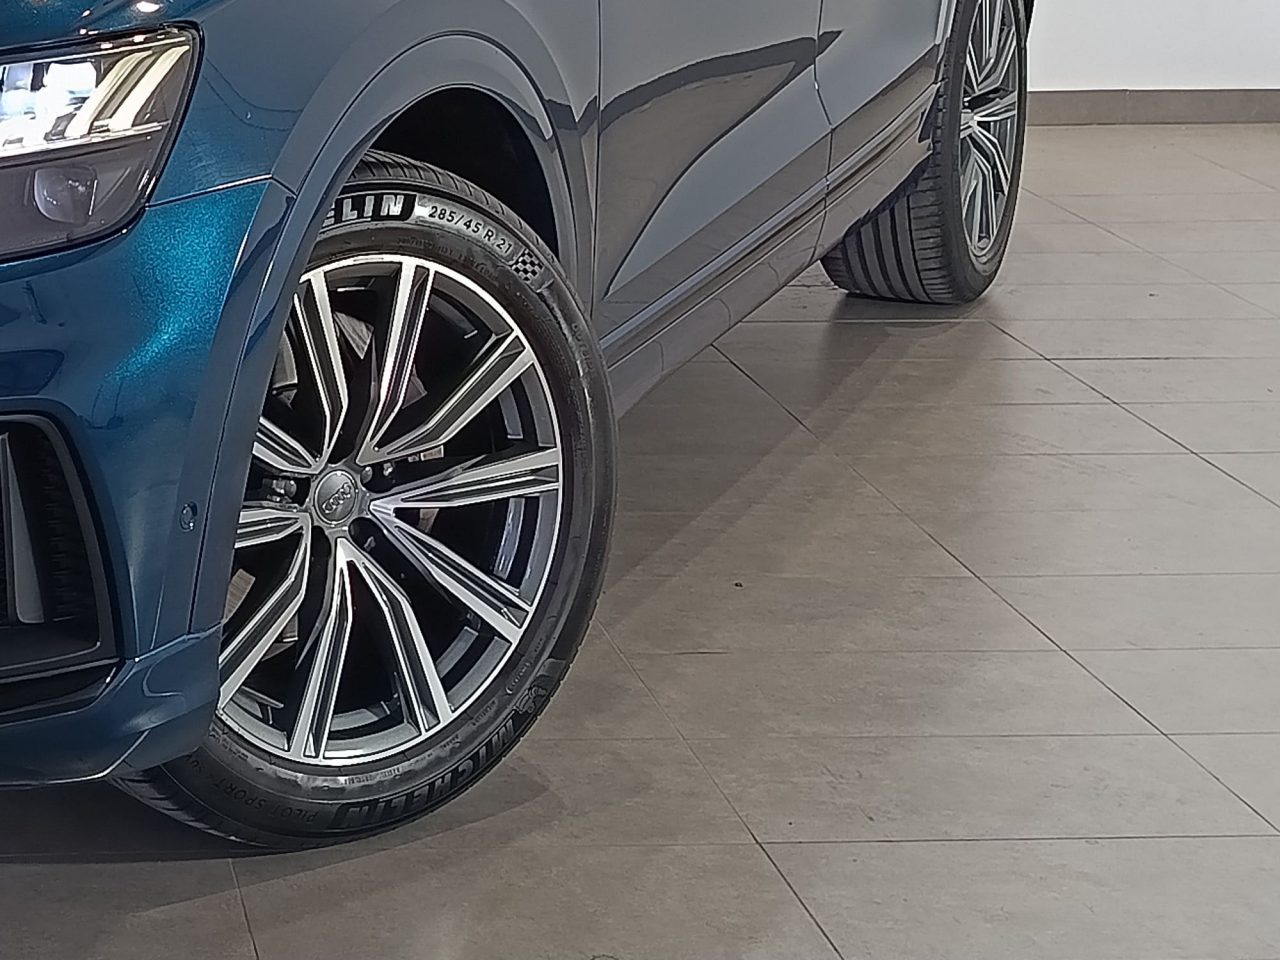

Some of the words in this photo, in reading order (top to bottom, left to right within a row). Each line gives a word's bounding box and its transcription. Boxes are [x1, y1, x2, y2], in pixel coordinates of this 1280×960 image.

[428, 204, 483, 235] 285/45
[483, 228, 495, 242] R
[496, 236, 513, 255] 21
[344, 718, 517, 823] MICHELIN
